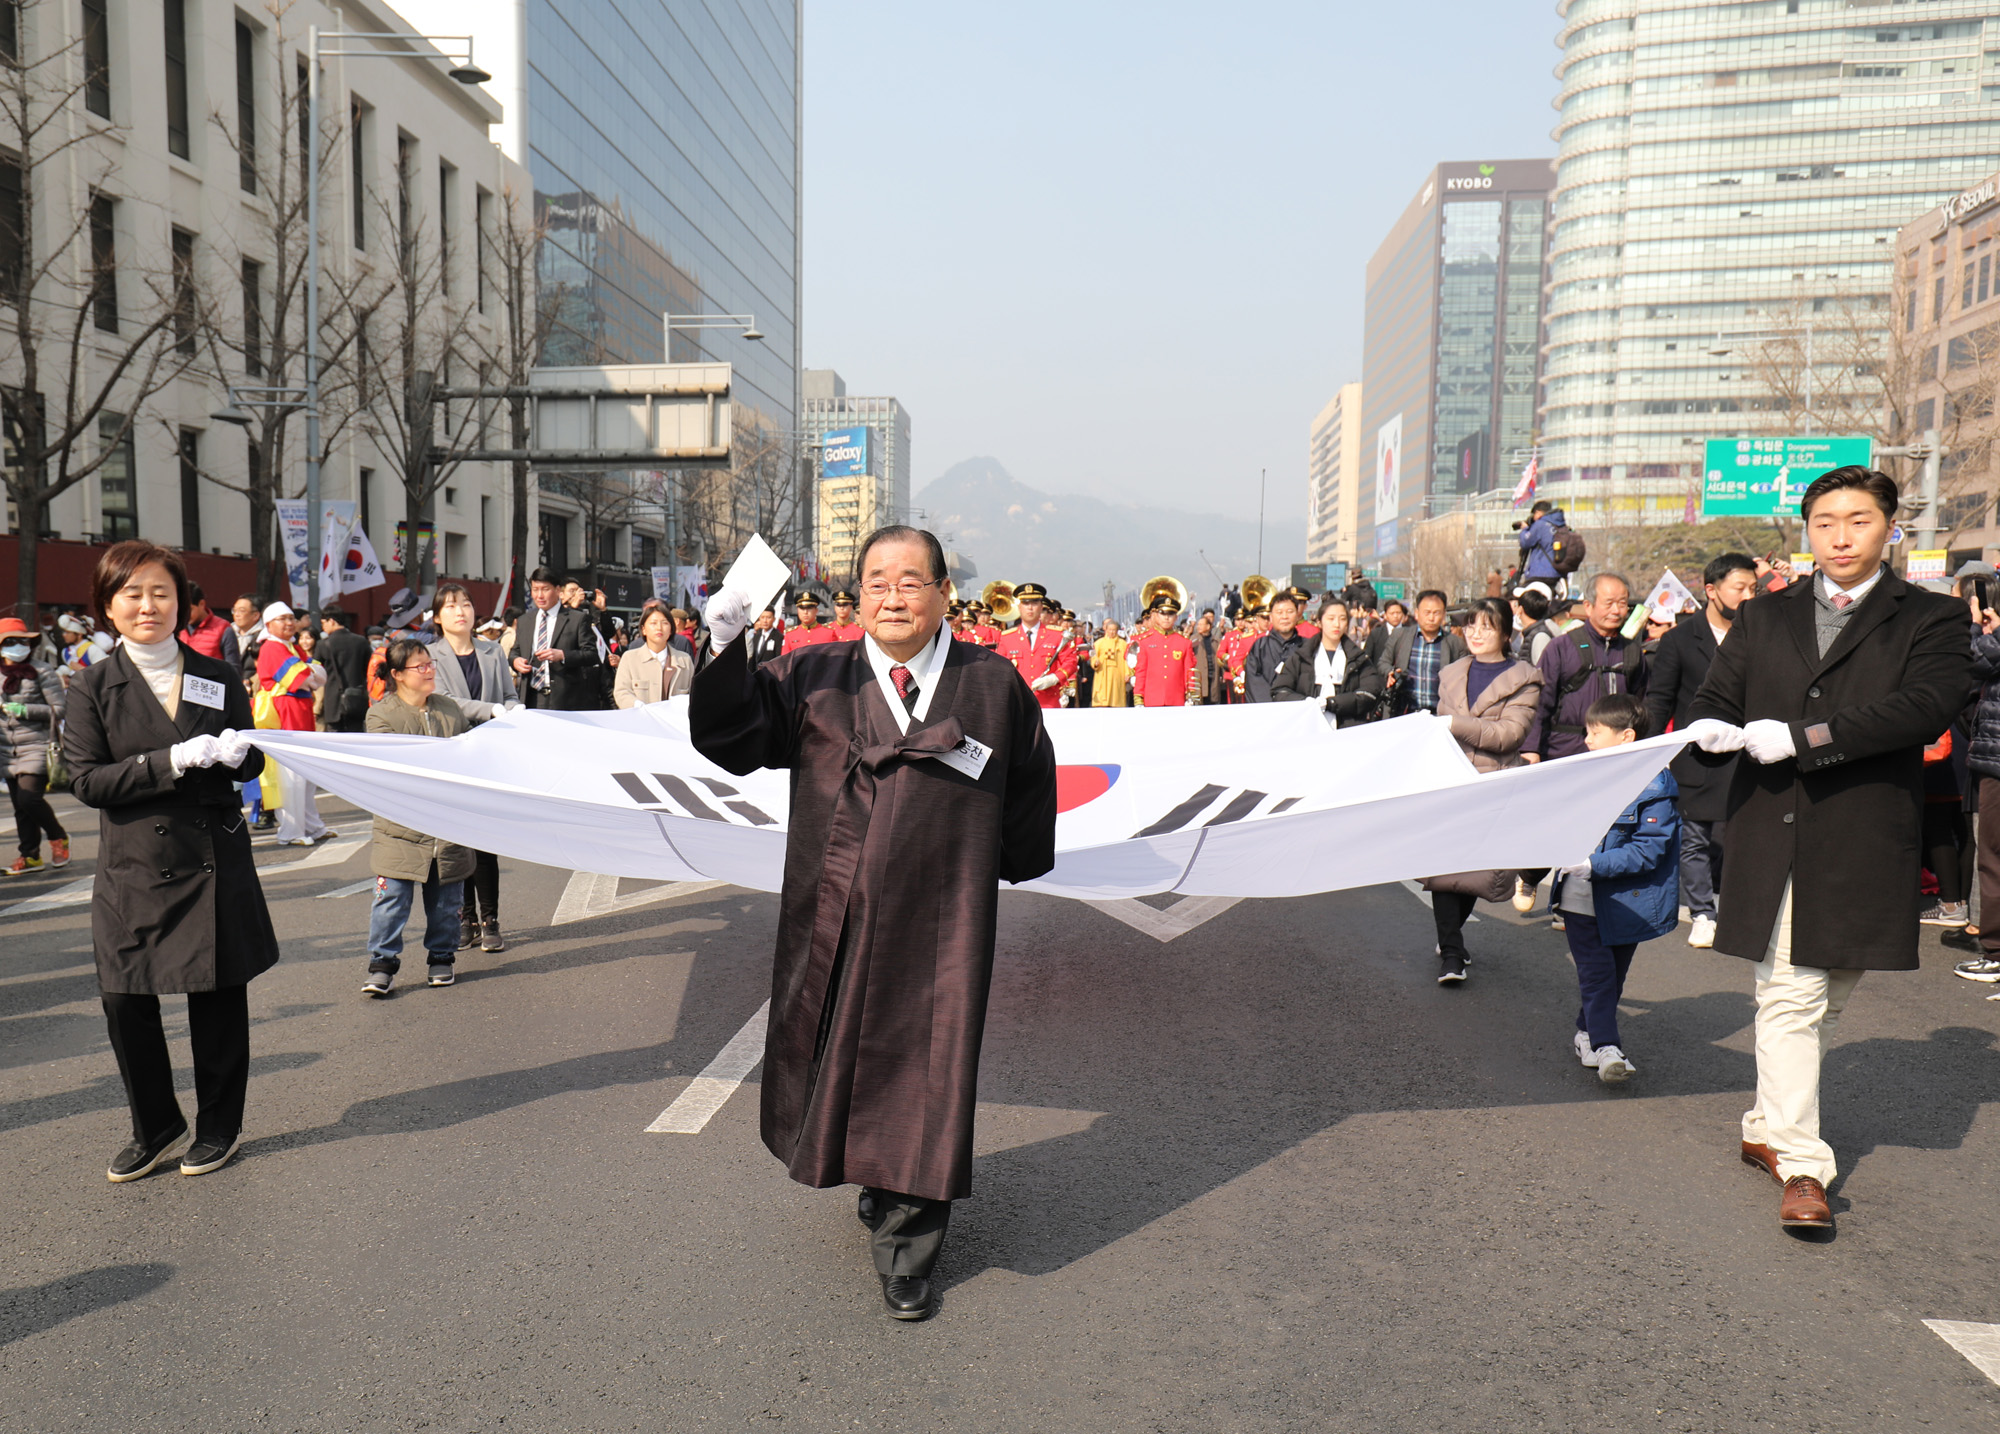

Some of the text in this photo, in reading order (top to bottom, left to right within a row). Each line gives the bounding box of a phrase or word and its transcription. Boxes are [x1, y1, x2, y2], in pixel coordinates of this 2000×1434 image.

[1447, 177, 1493, 189] KYOBO
[1959, 182, 1995, 215] SEOUL
[1754, 440, 1784, 452] 독립문
[824, 446, 863, 463] Galaxy
[1752, 454, 1783, 466] 광화문
[1706, 480, 1747, 493] 서대문역
[190, 679, 219, 697] 윤봉길
